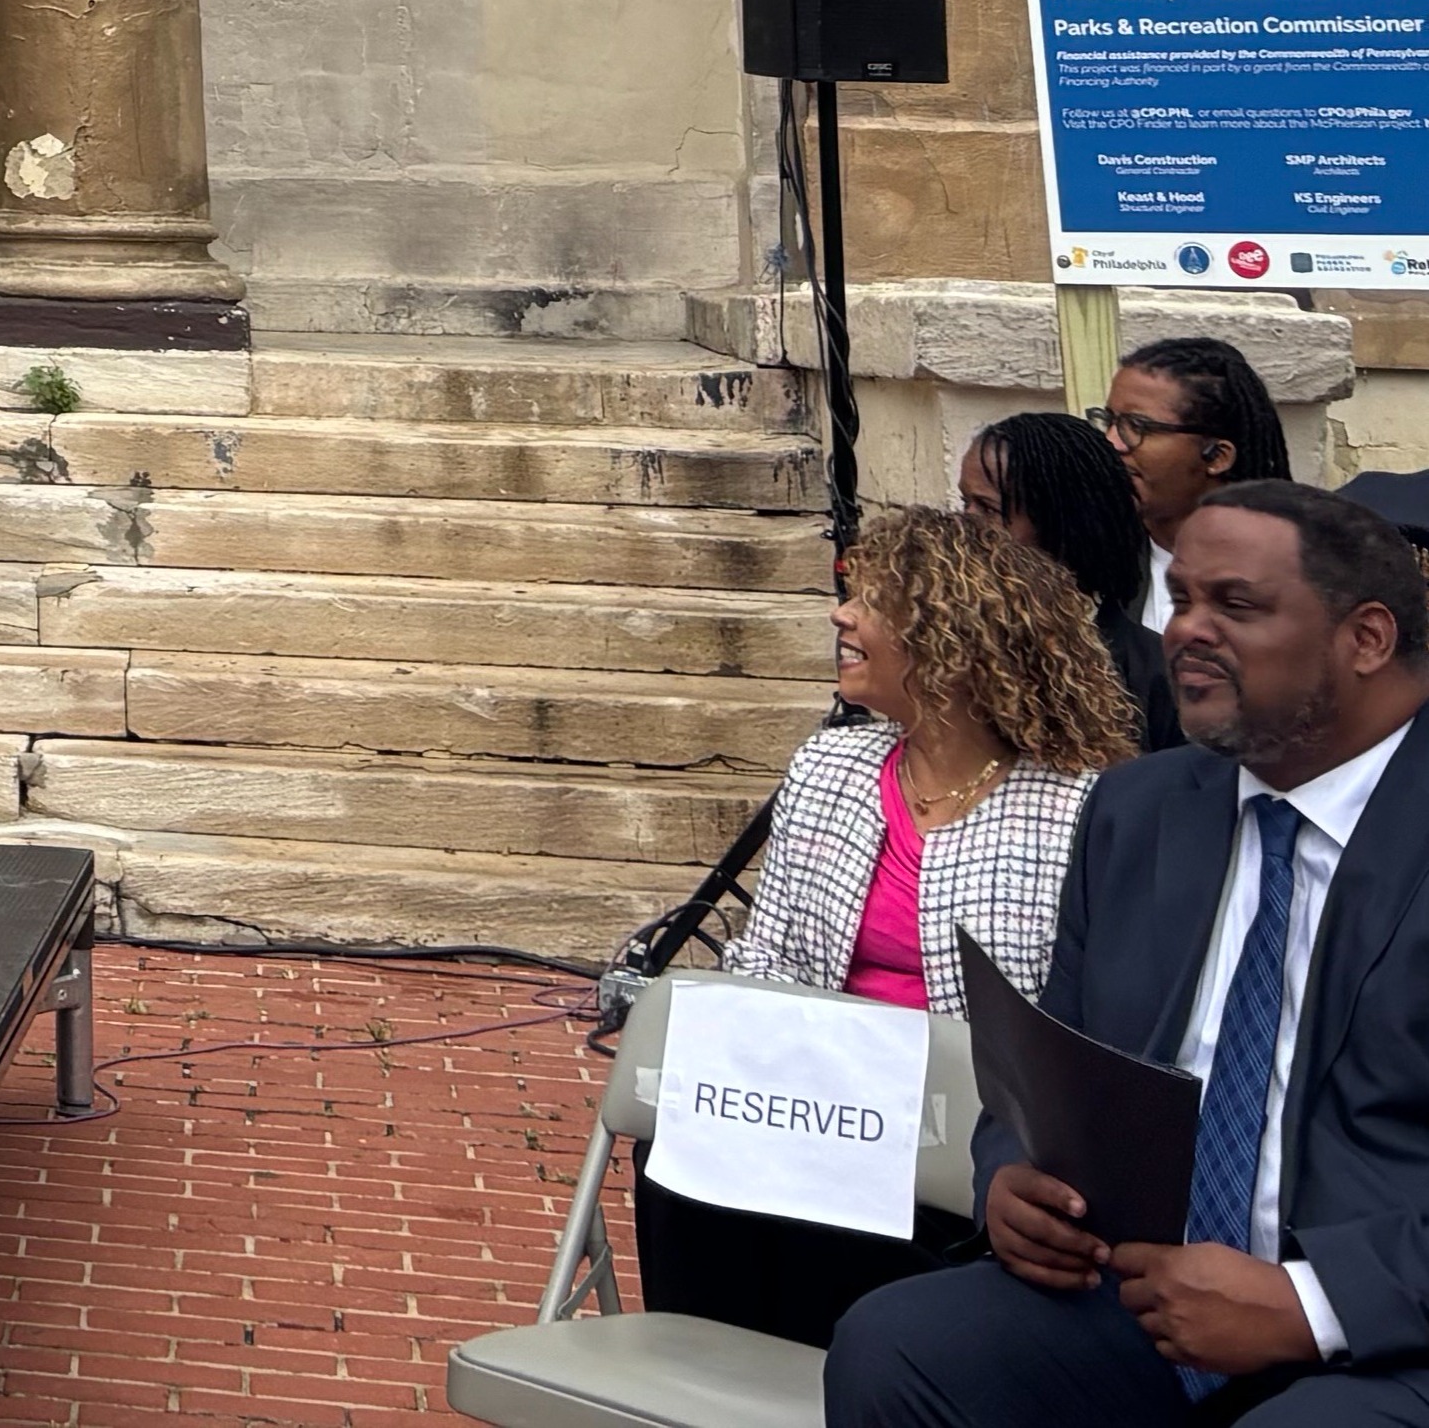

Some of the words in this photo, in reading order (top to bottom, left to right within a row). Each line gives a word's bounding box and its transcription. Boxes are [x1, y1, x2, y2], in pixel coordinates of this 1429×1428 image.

[1054, 19, 1114, 36] Parks
[1117, 18, 1135, 35] &
[1138, 16, 1259, 35] Recreation
[1263, 15, 1425, 34] Commissioner
[1056, 50, 1107, 61] Financial
[1109, 50, 1168, 60] assistance
[1169, 49, 1220, 62] provided
[1221, 49, 1237, 62] by
[1238, 49, 1257, 59] the
[1258, 48, 1349, 60] Commonwealth
[1351, 47, 1365, 60] of
[1059, 64, 1079, 74] This
[1080, 63, 1118, 75] project
[1120, 64, 1141, 73] was
[1143, 63, 1190, 75] financed
[1191, 63, 1201, 73] in
[1203, 63, 1226, 75] part
[1227, 62, 1242, 75] by
[1243, 63, 1251, 73] a
[1252, 62, 1283, 74] grant
[1284, 61, 1312, 74] from
[1313, 61, 1331, 72] the
[1332, 60, 1422, 72] Commonwealth
[1059, 76, 1110, 88] Financing
[1062, 107, 1100, 118] Follow
[1101, 109, 1116, 118] us
[1117, 108, 1130, 118] at
[1197, 109, 1210, 118] or
[1211, 107, 1245, 118] email
[1245, 108, 1303, 120] questions
[1304, 107, 1318, 118] to
[1062, 119, 1085, 129] Visit
[1088, 119, 1107, 129] the
[1108, 119, 1135, 129] CPO
[1174, 119, 1187, 129] to
[1189, 119, 1218, 129] learn
[1219, 119, 1251, 129] more
[1252, 118, 1288, 129] about
[1288, 119, 1309, 129] the
[1097, 154, 1133, 165] Davis
[1134, 154, 1218, 166] Construction
[1285, 154, 1316, 166] SMP
[1317, 154, 1387, 166] Architects
[1117, 191, 1154, 203] Keast
[1156, 191, 1167, 203] &
[1168, 191, 1205, 203] Hood
[1294, 192, 1313, 204] KS
[1314, 192, 1383, 206] Engineers
[1092, 259, 1168, 271] Philadelphia
[695, 1082, 885, 1142] RESERVED
